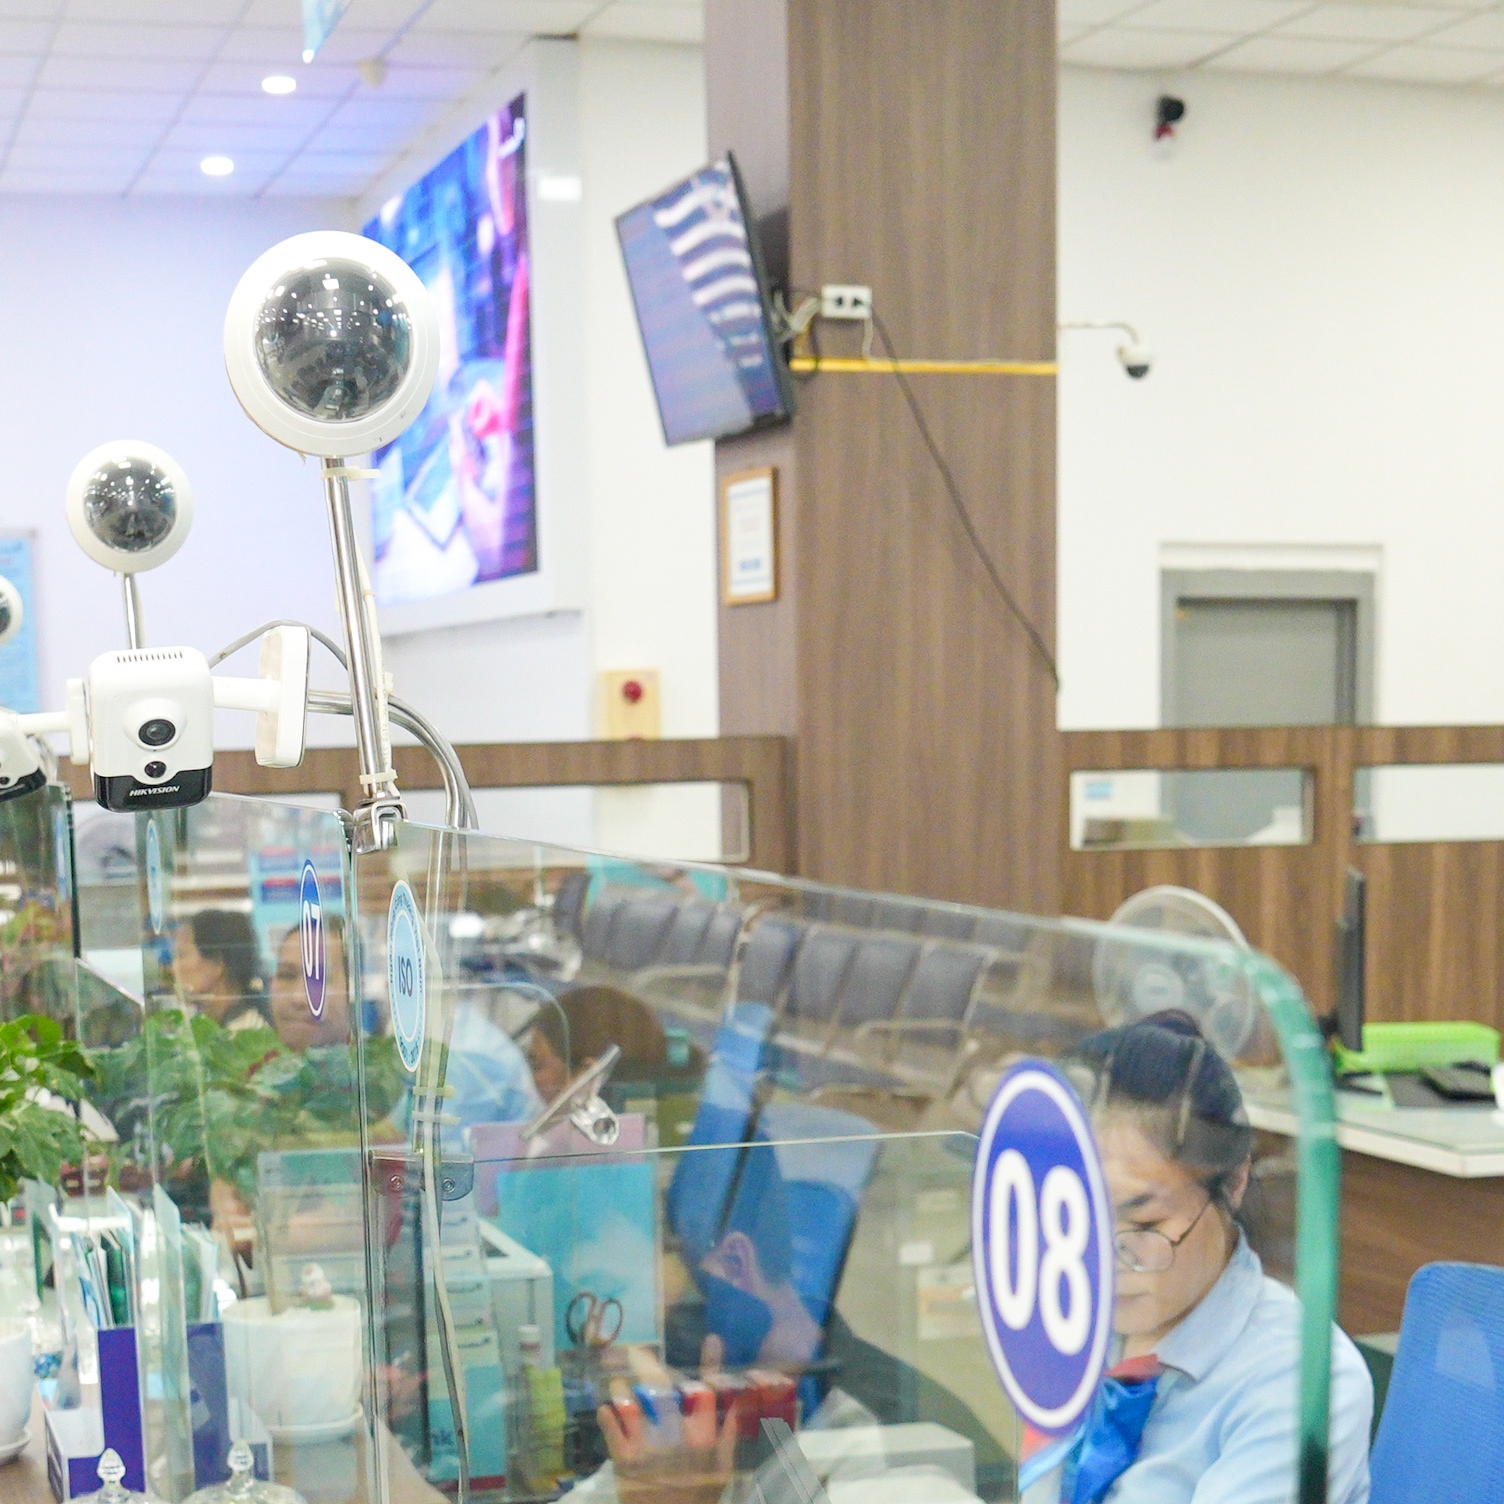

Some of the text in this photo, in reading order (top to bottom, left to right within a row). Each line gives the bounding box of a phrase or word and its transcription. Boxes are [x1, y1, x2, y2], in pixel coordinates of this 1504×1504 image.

[129, 785, 180, 797] HIKVISION
[303, 899, 320, 980] 07
[398, 955, 414, 997] ISO
[989, 1148, 1092, 1356] 08
